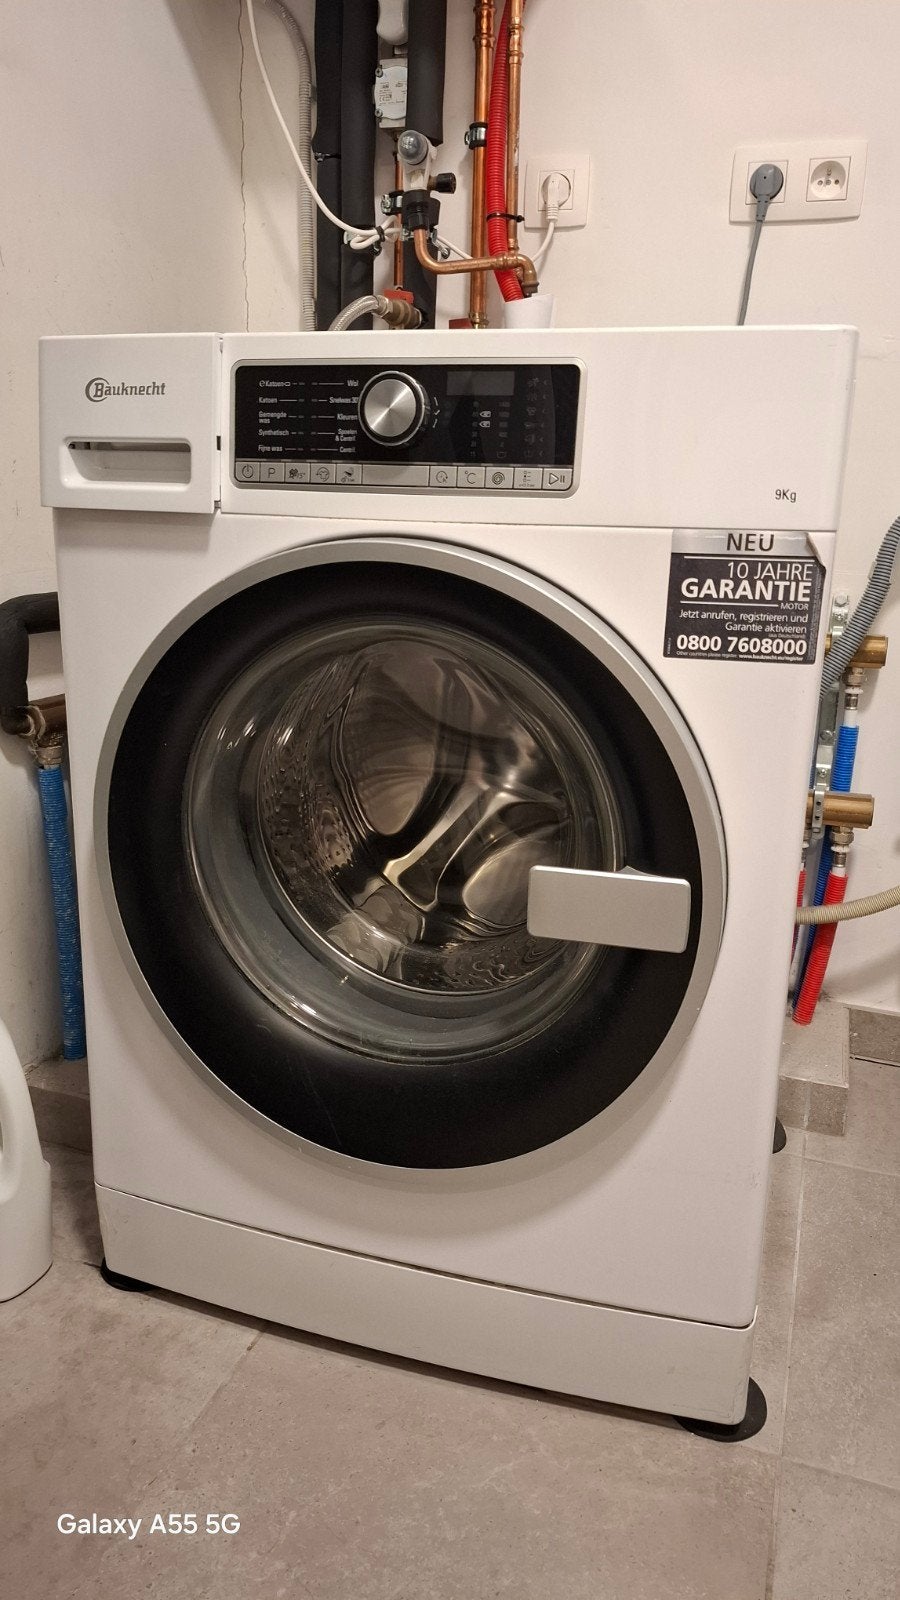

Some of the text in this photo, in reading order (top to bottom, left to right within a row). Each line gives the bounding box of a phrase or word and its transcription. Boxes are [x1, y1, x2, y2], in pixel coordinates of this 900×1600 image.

[86, 378, 166, 401] Bauknecht
[259, 411, 287, 419] Gemengde
[268, 468, 276, 478] P
[775, 488, 797, 503] 9Kg
[726, 533, 775, 552] NEU
[727, 561, 813, 581] 10 JAHRE
[681, 577, 811, 602] GARANTIE
[780, 602, 809, 611] MOTOR
[679, 609, 809, 623] Jetzt anrufen, registrieren und
[725, 622, 807, 634] Garantie aktivieren
[676, 634, 722, 651] 0800
[727, 636, 807, 656] 7608000
